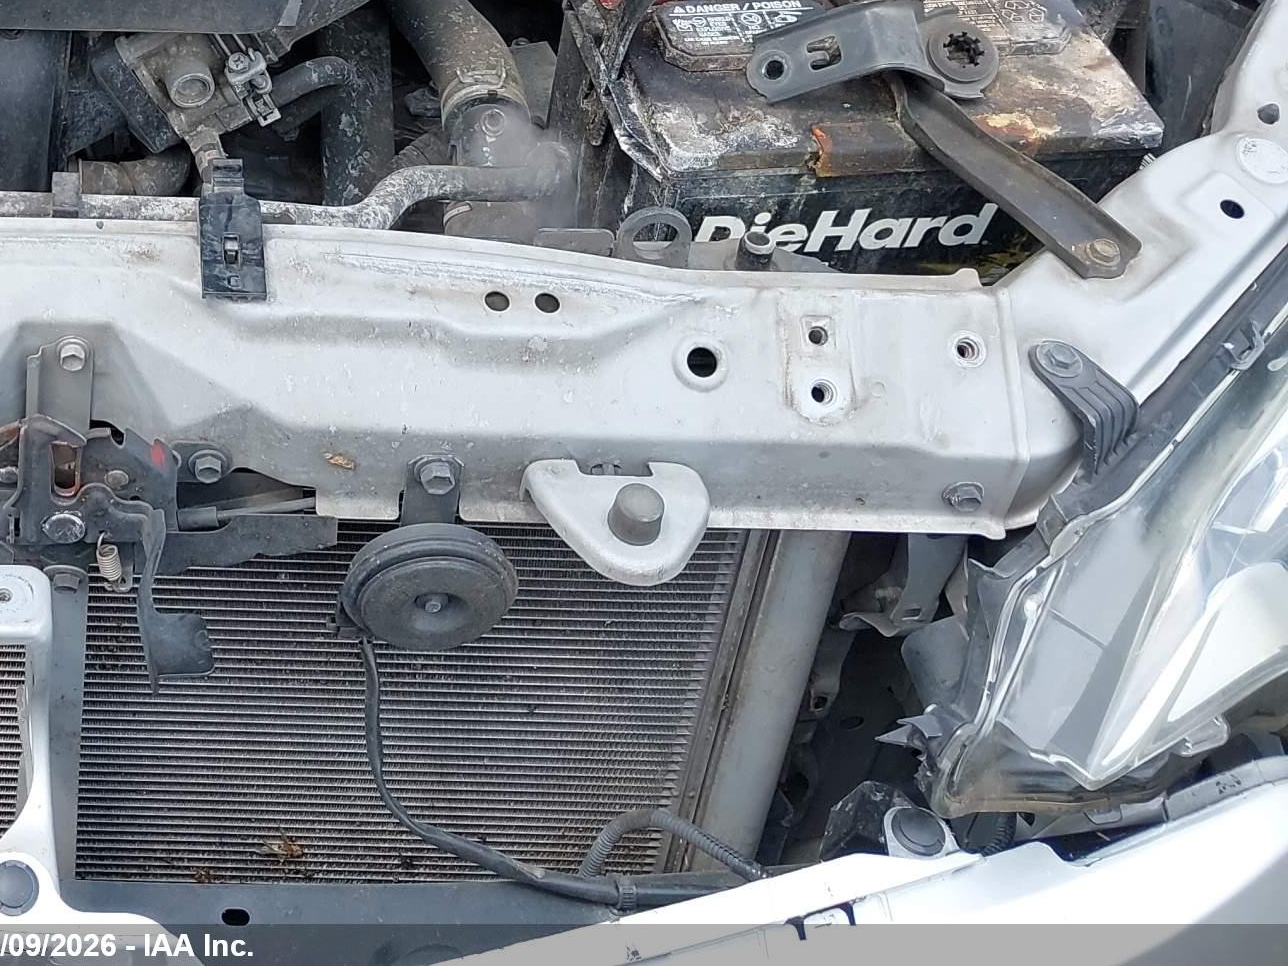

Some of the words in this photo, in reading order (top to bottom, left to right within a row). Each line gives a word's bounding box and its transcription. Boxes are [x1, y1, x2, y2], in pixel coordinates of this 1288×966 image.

[685, 2, 741, 14] DANGER
[751, 0, 802, 11] POISON
[694, 202, 999, 253] DieHard
